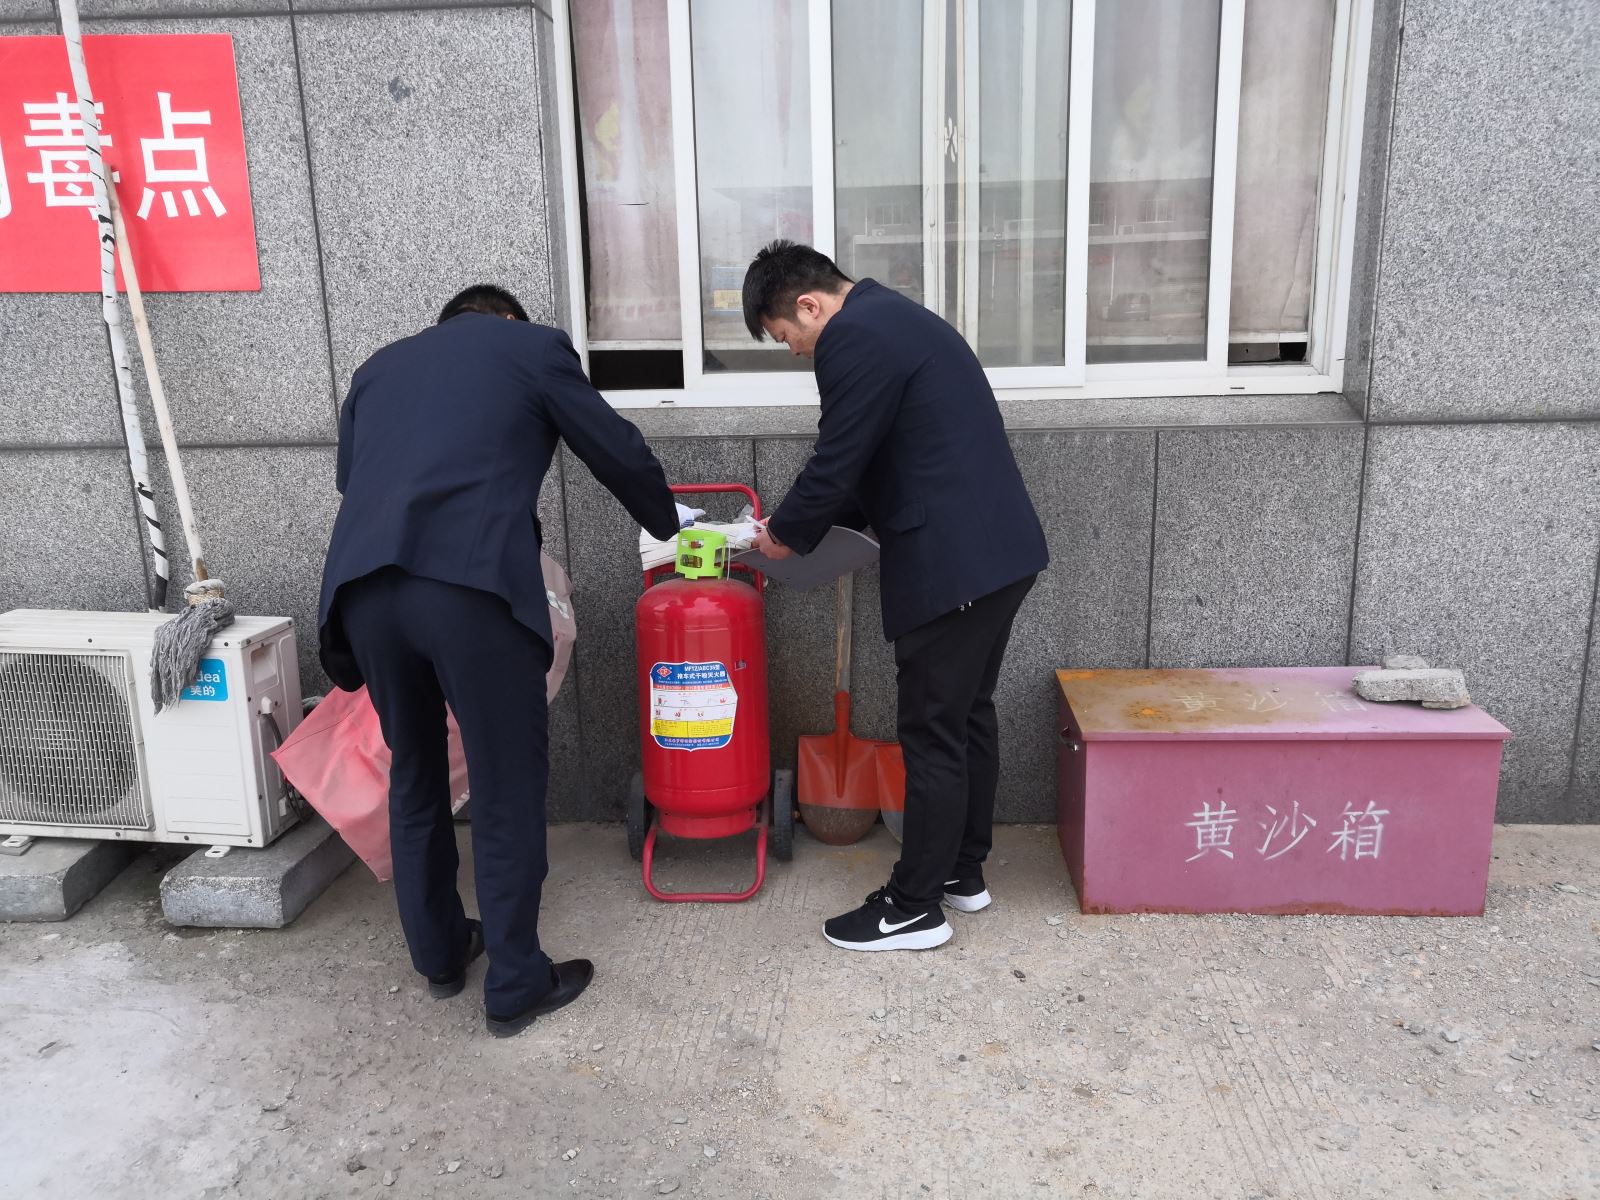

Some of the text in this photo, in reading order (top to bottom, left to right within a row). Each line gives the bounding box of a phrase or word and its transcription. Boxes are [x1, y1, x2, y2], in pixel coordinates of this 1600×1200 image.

[0, 91, 227, 220] 毒点
[677, 670, 726, 680] 推车式干粉灭火器
[190, 685, 216, 697] 美的
[1173, 691, 1368, 713] 黄沙箱
[1184, 800, 1390, 862] 黄沙箱
